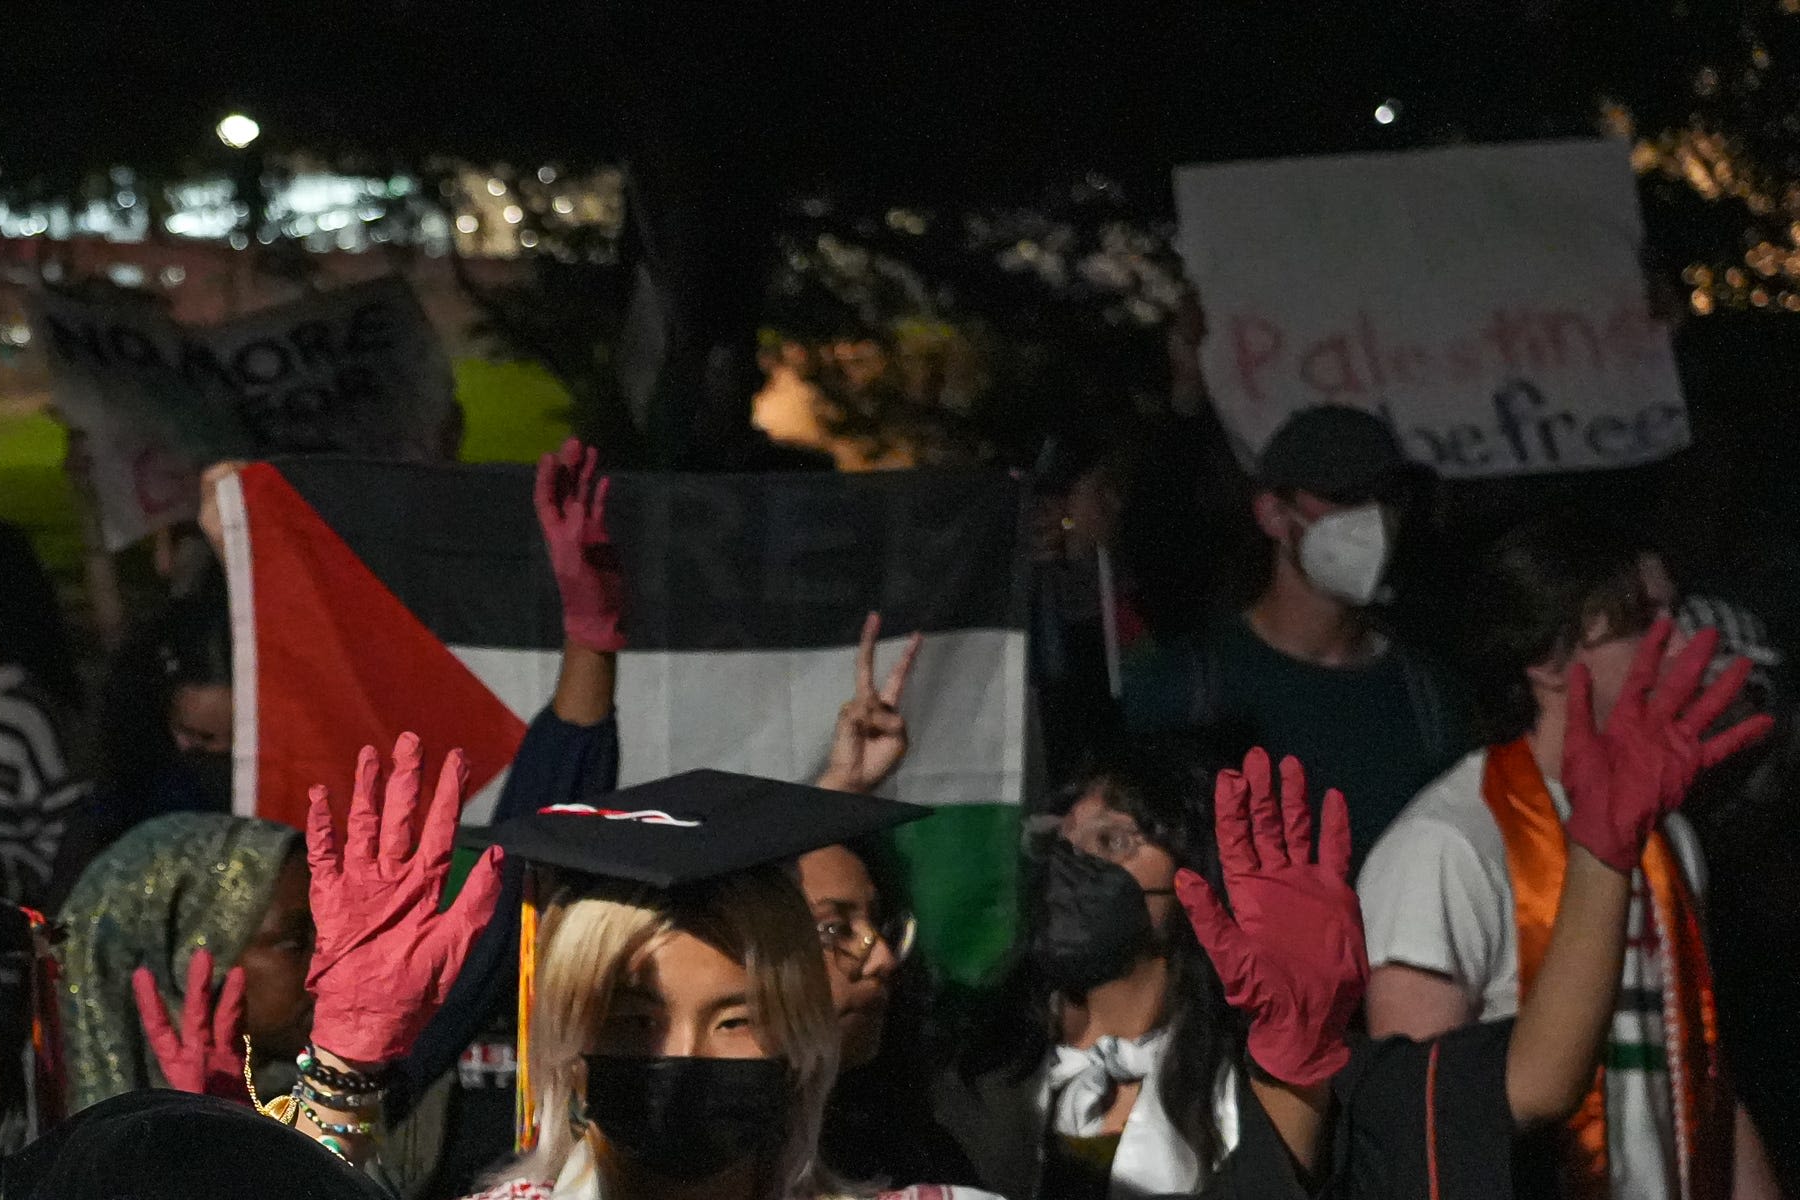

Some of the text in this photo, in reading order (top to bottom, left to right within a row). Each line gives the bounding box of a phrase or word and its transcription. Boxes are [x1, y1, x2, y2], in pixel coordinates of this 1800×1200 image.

[45, 301, 396, 390] NO MORE
[1494, 378, 1687, 464] free
